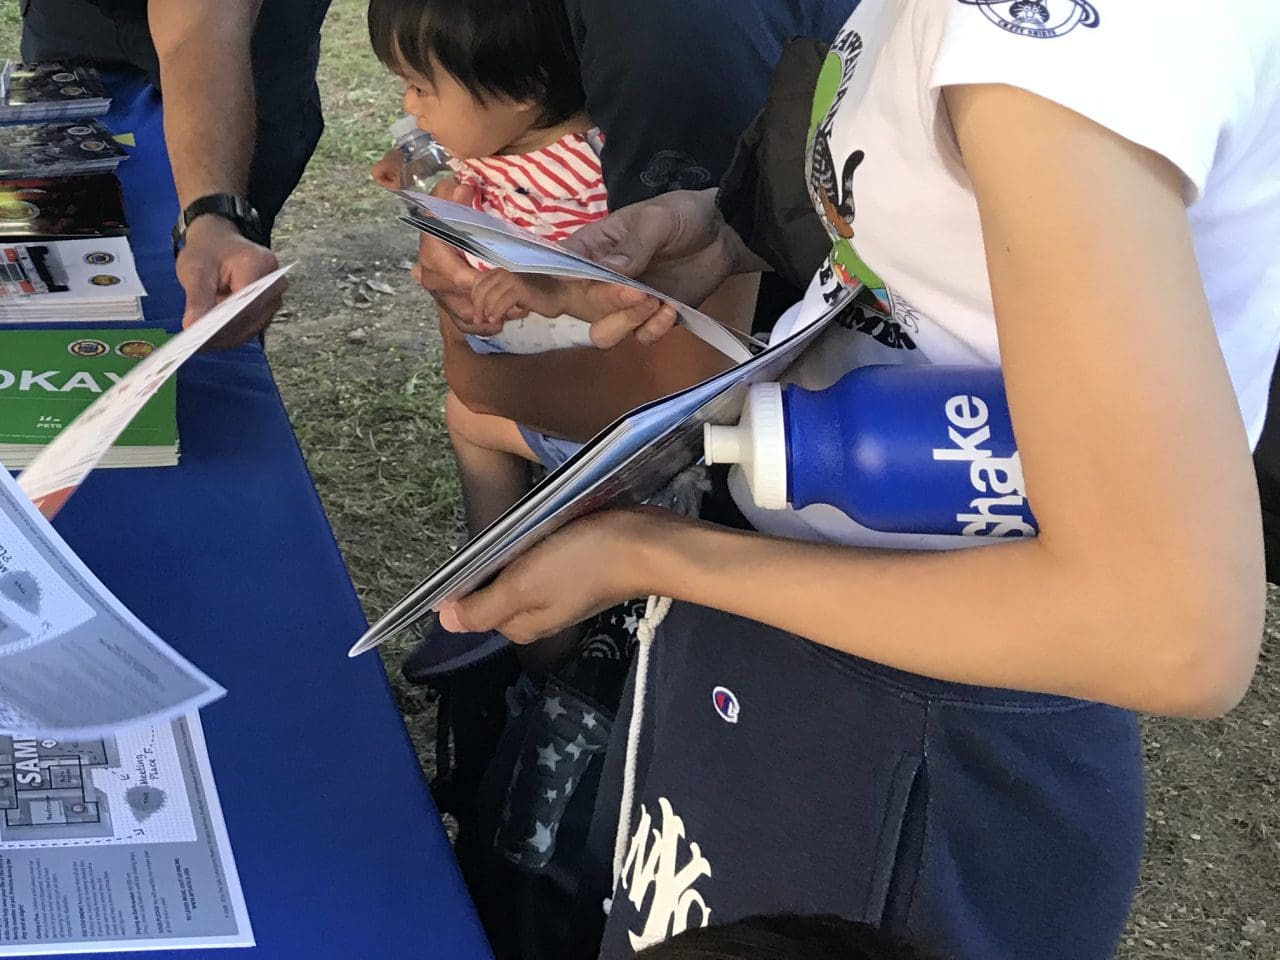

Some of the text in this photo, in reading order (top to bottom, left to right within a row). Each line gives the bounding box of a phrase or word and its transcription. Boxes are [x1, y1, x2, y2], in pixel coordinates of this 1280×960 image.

[12, 734, 42, 787] SAM
[135, 754, 149, 785] Meeting
[149, 758, 159, 781] Place
